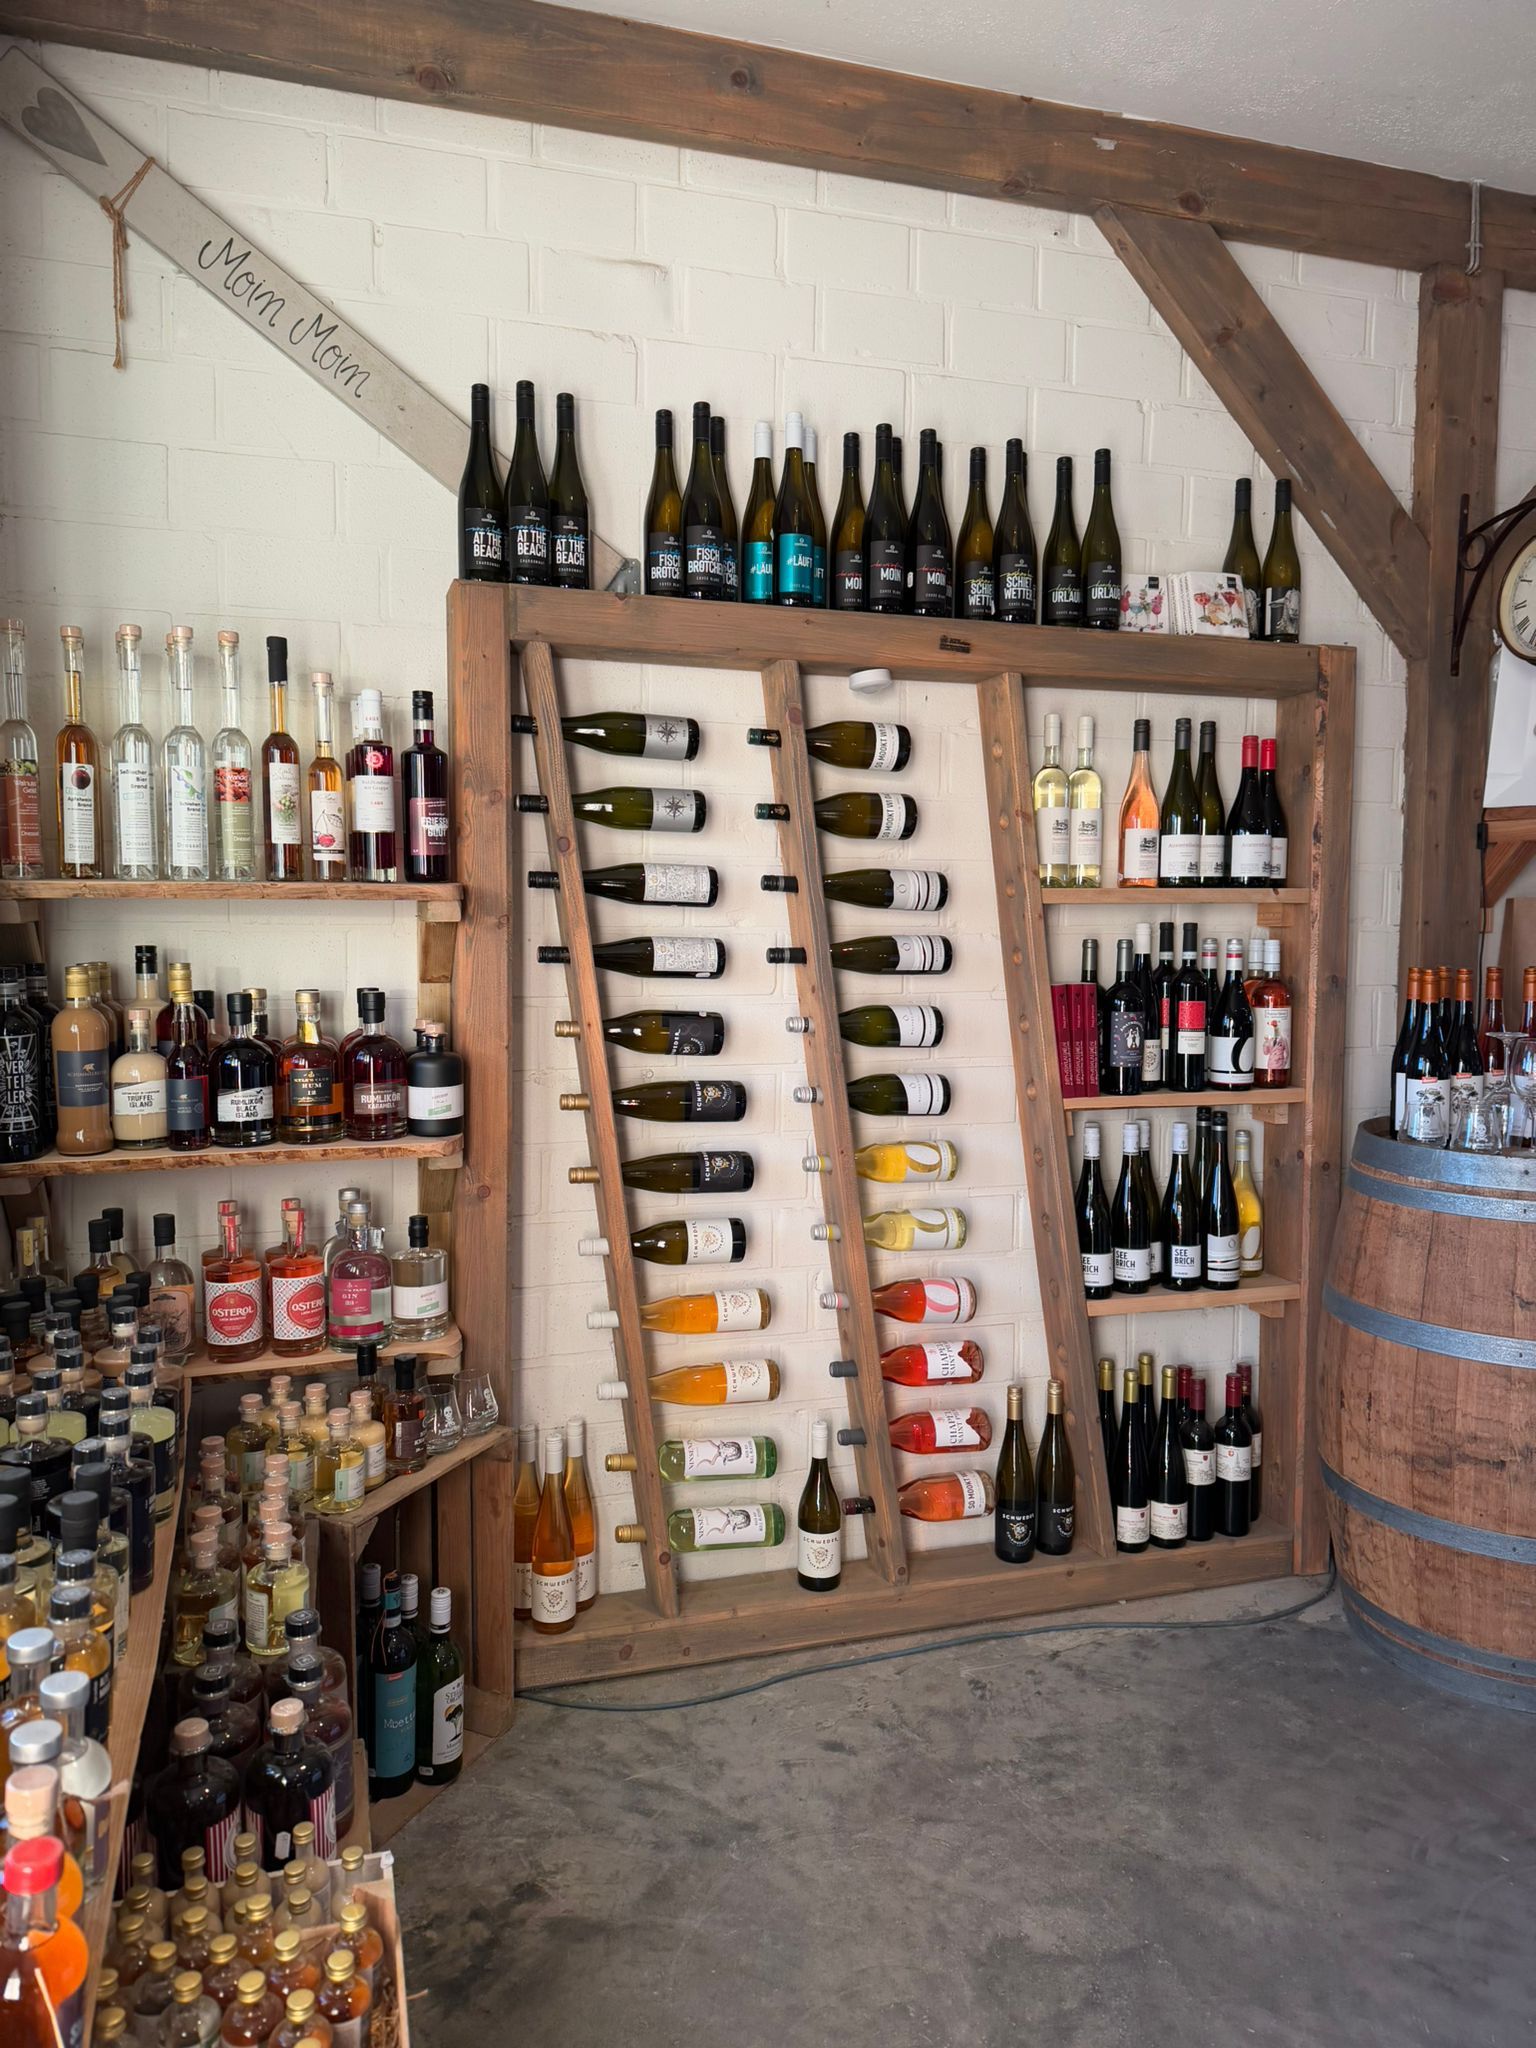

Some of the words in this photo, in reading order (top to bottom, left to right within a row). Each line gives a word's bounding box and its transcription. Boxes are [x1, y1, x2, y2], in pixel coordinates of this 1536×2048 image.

[198, 236, 291, 327] Moin
[289, 313, 372, 399] Moin
[473, 531, 485, 545] AT
[486, 532, 502, 546] THE
[517, 529, 529, 543] AT
[530, 530, 547, 545] THE
[473, 545, 502, 560] BEACH
[517, 542, 547, 558] BEACH
[556, 539, 566, 552] AT
[569, 539, 585, 553] THE
[556, 552, 585, 567] BEACH
[696, 548, 720, 562] FISCH
[786, 554, 813, 569] #LÄUFT
[880, 568, 901, 582] MOIN
[1006, 576, 1032, 588] SCHIET
[845, 577, 862, 590] MOI
[970, 583, 993, 595] SCHIE
[1003, 588, 1033, 601] WETTER
[878, 738, 888, 761] MOOKT
[885, 809, 895, 831] MOOKT
[5, 1060, 25, 1074] VER
[6, 1075, 24, 1089] TEI
[7, 1090, 26, 1105] LER
[361, 1093, 401, 1104] RUMLIKÖR
[1115, 1250, 1128, 1260] SEE
[1174, 1248, 1189, 1257] SEE
[1082, 1256, 1091, 1265] EE
[1115, 1258, 1136, 1268] BRICH
[1174, 1256, 1195, 1265] BRICH
[1082, 1265, 1099, 1273] RICH
[212, 1305, 254, 1318] OSTEROL
[956, 1422, 964, 1444] SAINT
[963, 1478, 975, 1500] MOOKT
